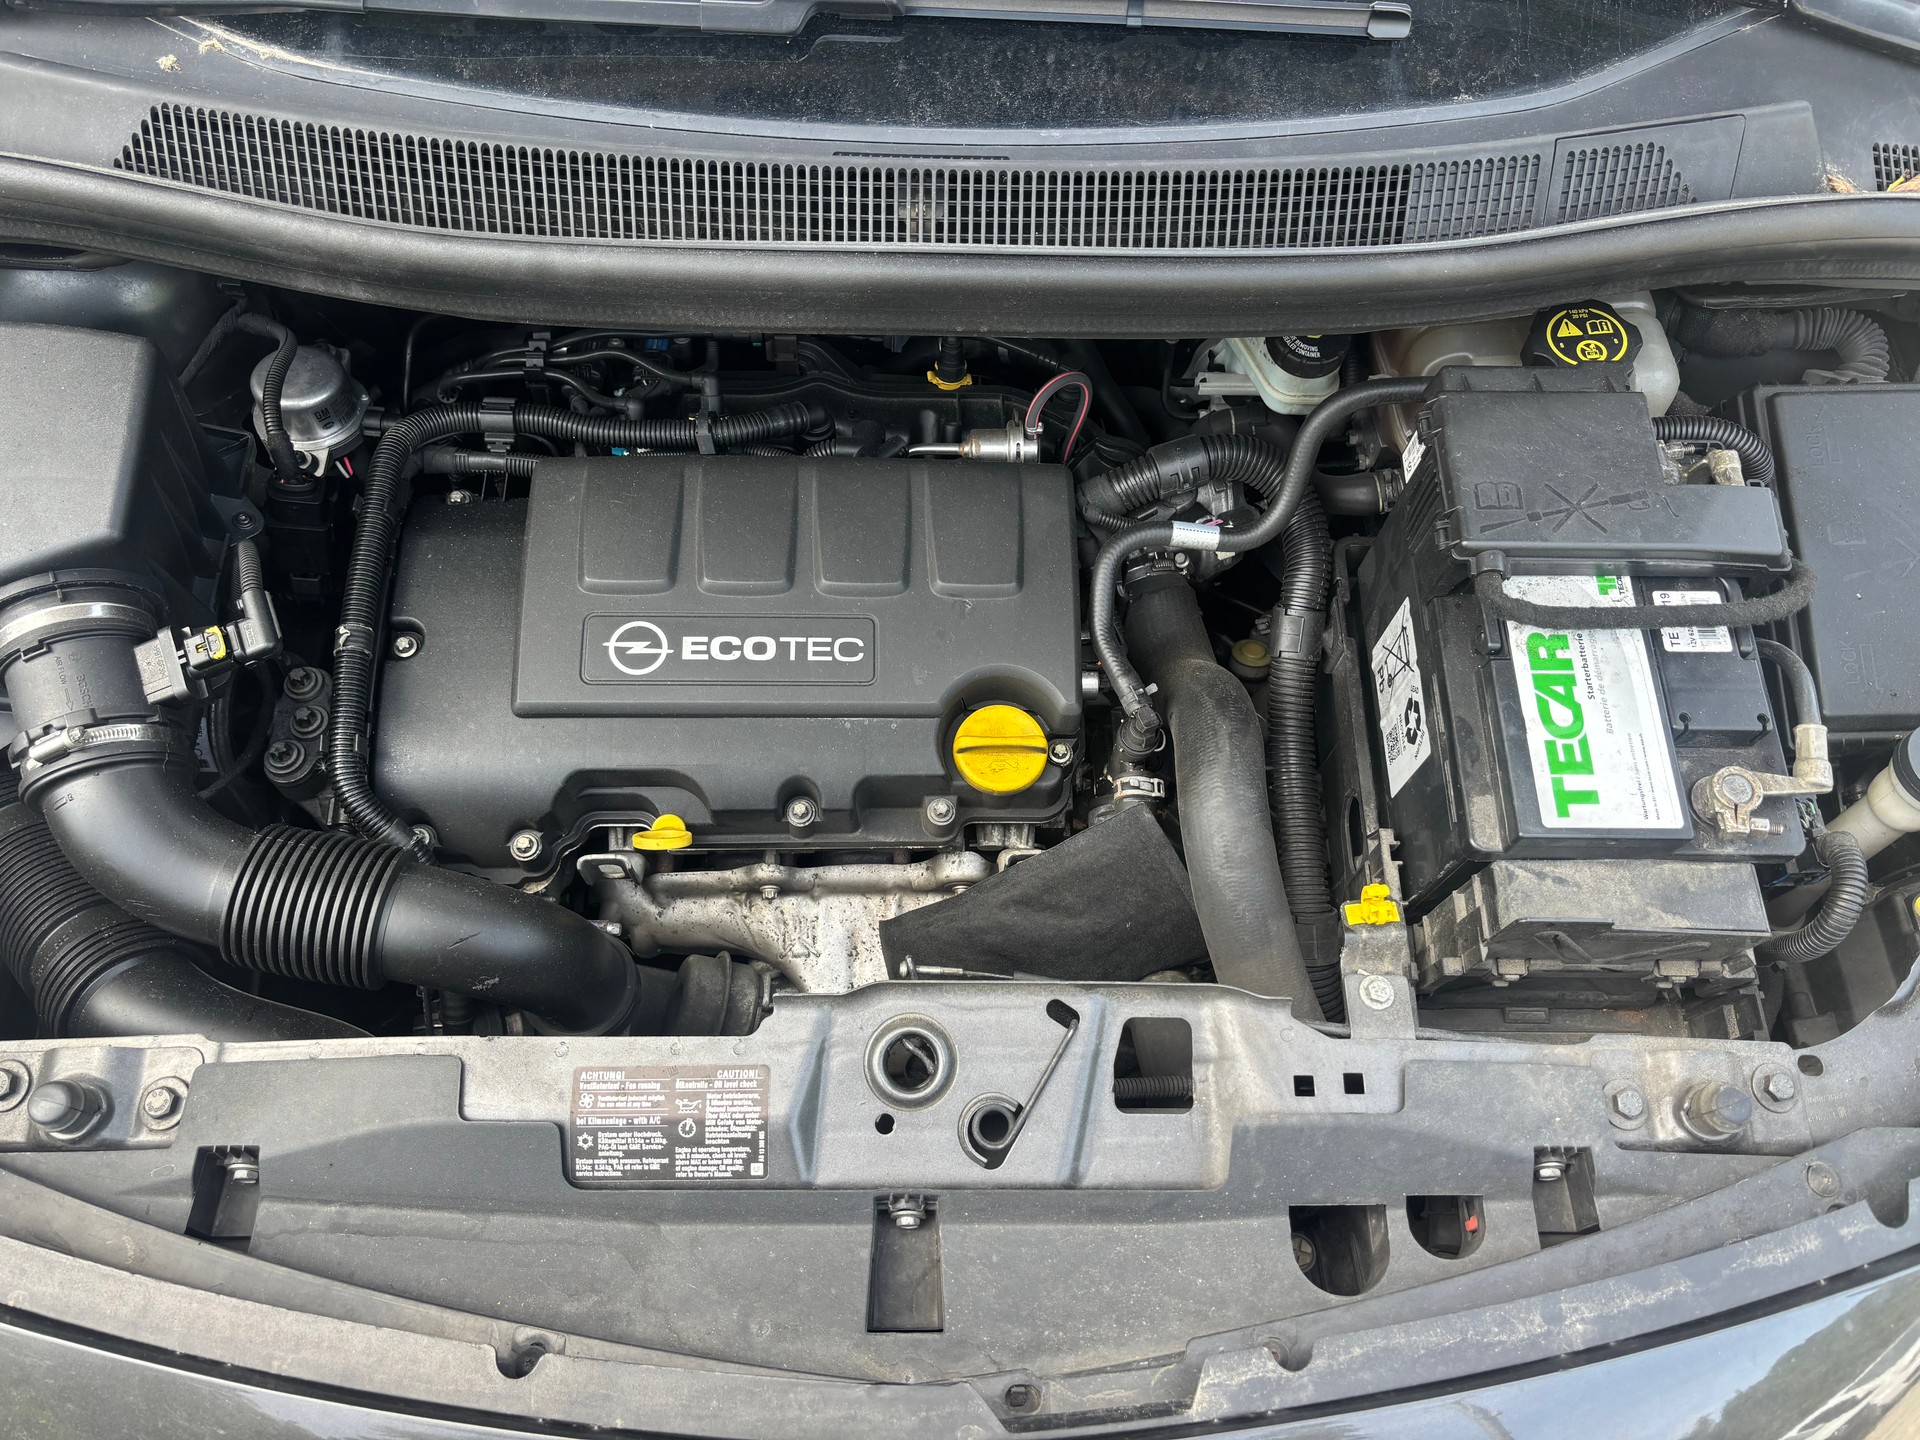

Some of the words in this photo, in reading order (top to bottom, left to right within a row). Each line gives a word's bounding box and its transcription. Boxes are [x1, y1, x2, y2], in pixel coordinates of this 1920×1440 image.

[1295, 340, 1318, 352] REMOVING
[1296, 347, 1321, 358] CONTAINER
[314, 407, 330, 420] GM
[682, 635, 864, 662] ECOTEC
[1576, 633, 1595, 699] Starterbatterie
[1377, 665, 1385, 694] Pb
[1598, 685, 1605, 694] de
[1601, 698, 1613, 734] Batterie
[1525, 633, 1600, 818] TECAR
[580, 1071, 625, 1080] ACHTUNG!
[717, 1069, 758, 1078] CAUTION!
[649, 1116, 661, 1124] A/C
